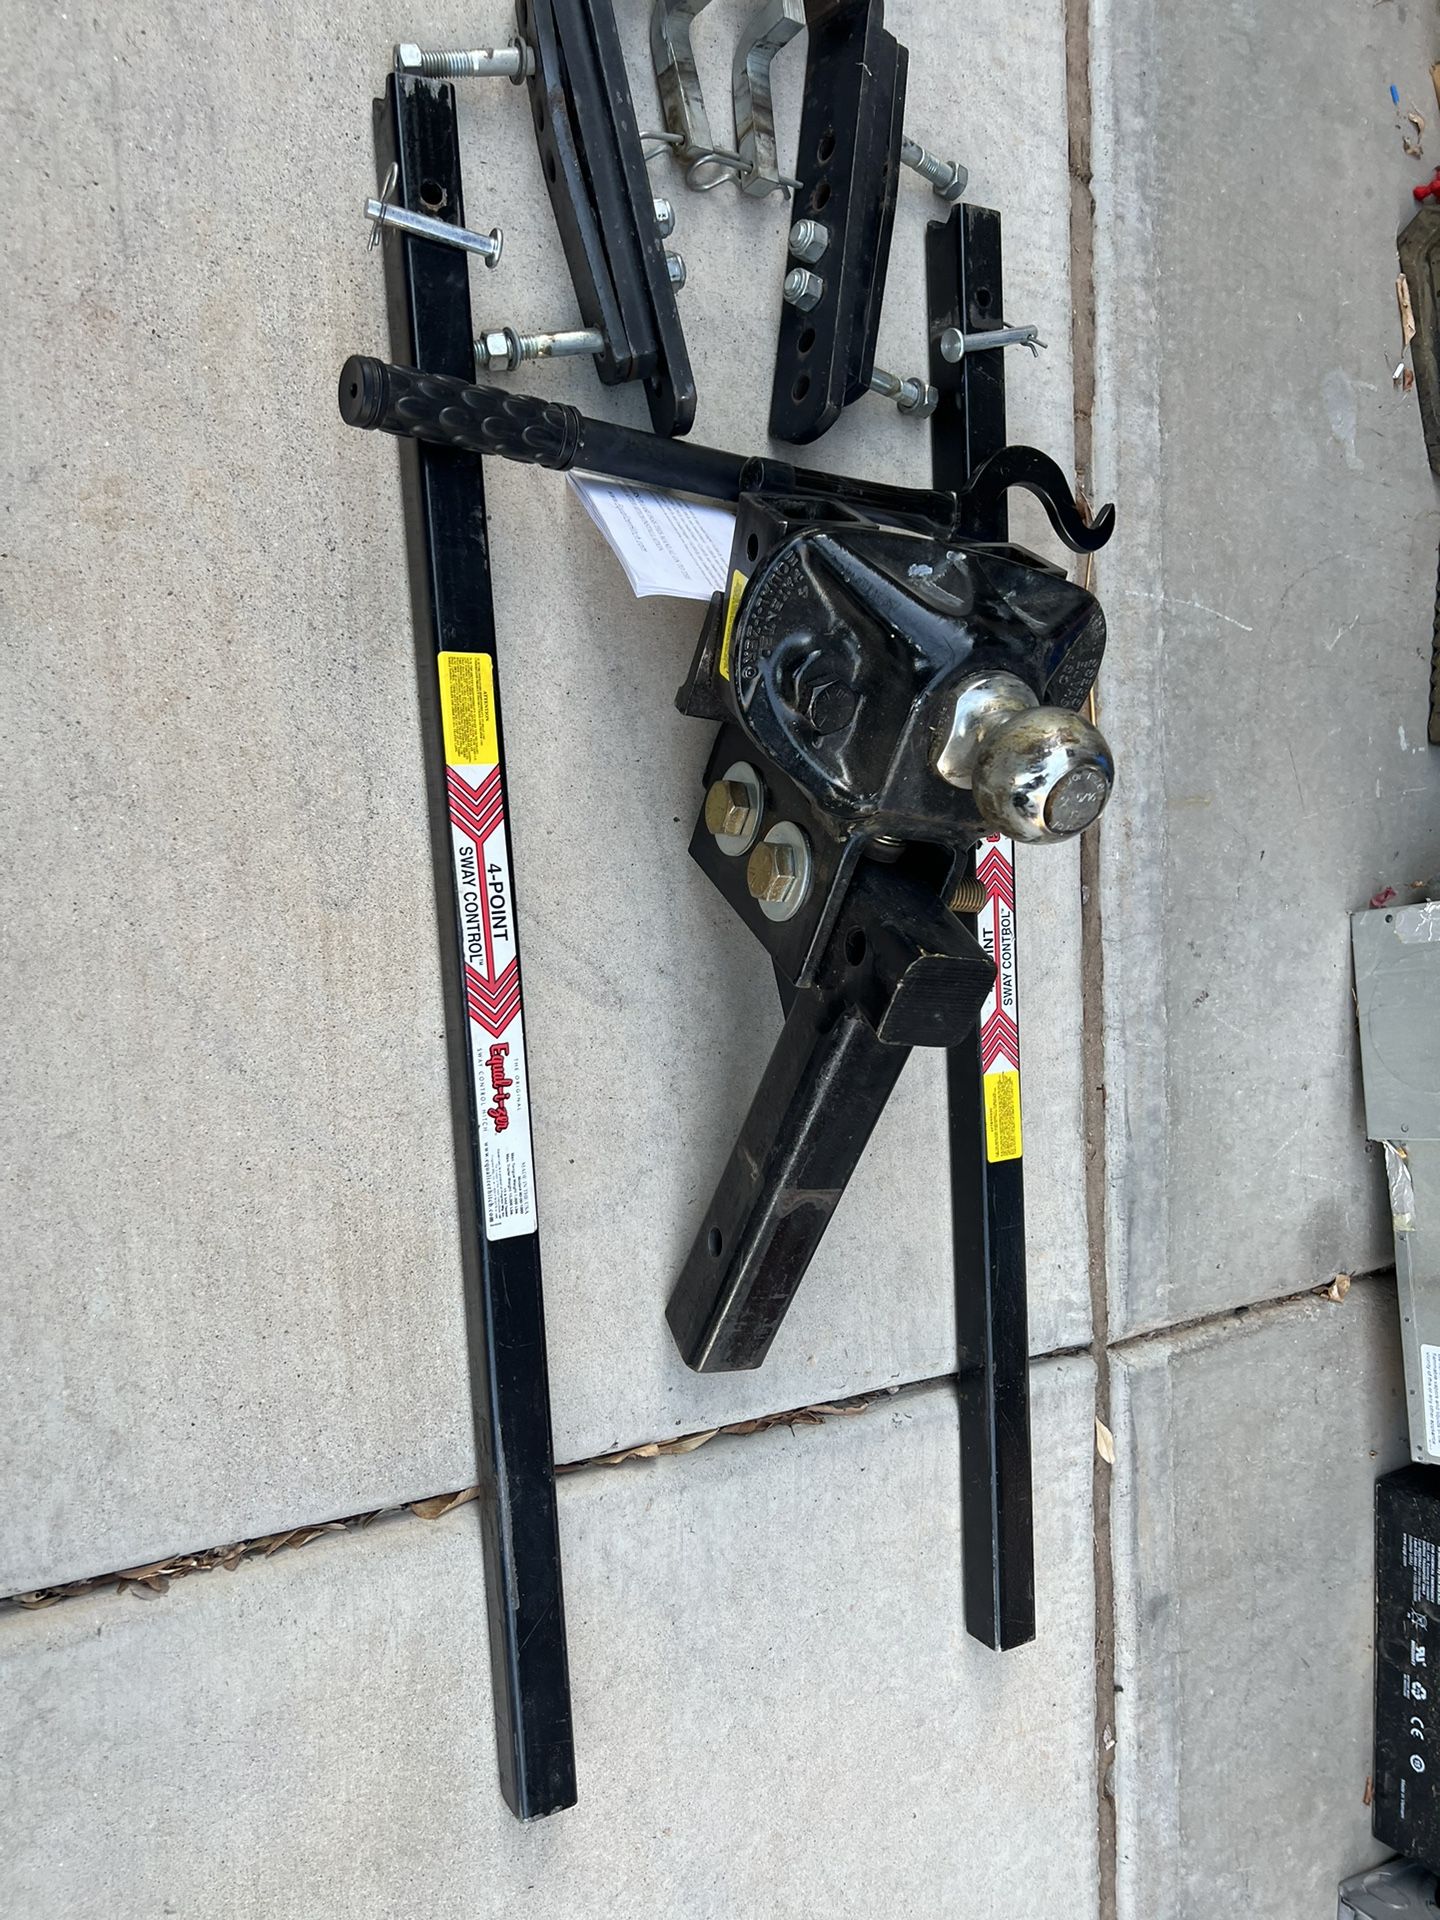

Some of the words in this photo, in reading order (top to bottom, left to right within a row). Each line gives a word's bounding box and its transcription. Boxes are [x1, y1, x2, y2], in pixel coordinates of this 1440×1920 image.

[459, 846, 476, 887] SWAY
[487, 863, 508, 941] 4-POINT
[1002, 973, 1013, 1006] SWAY
[485, 1042, 513, 1133] Equal-i-zer
